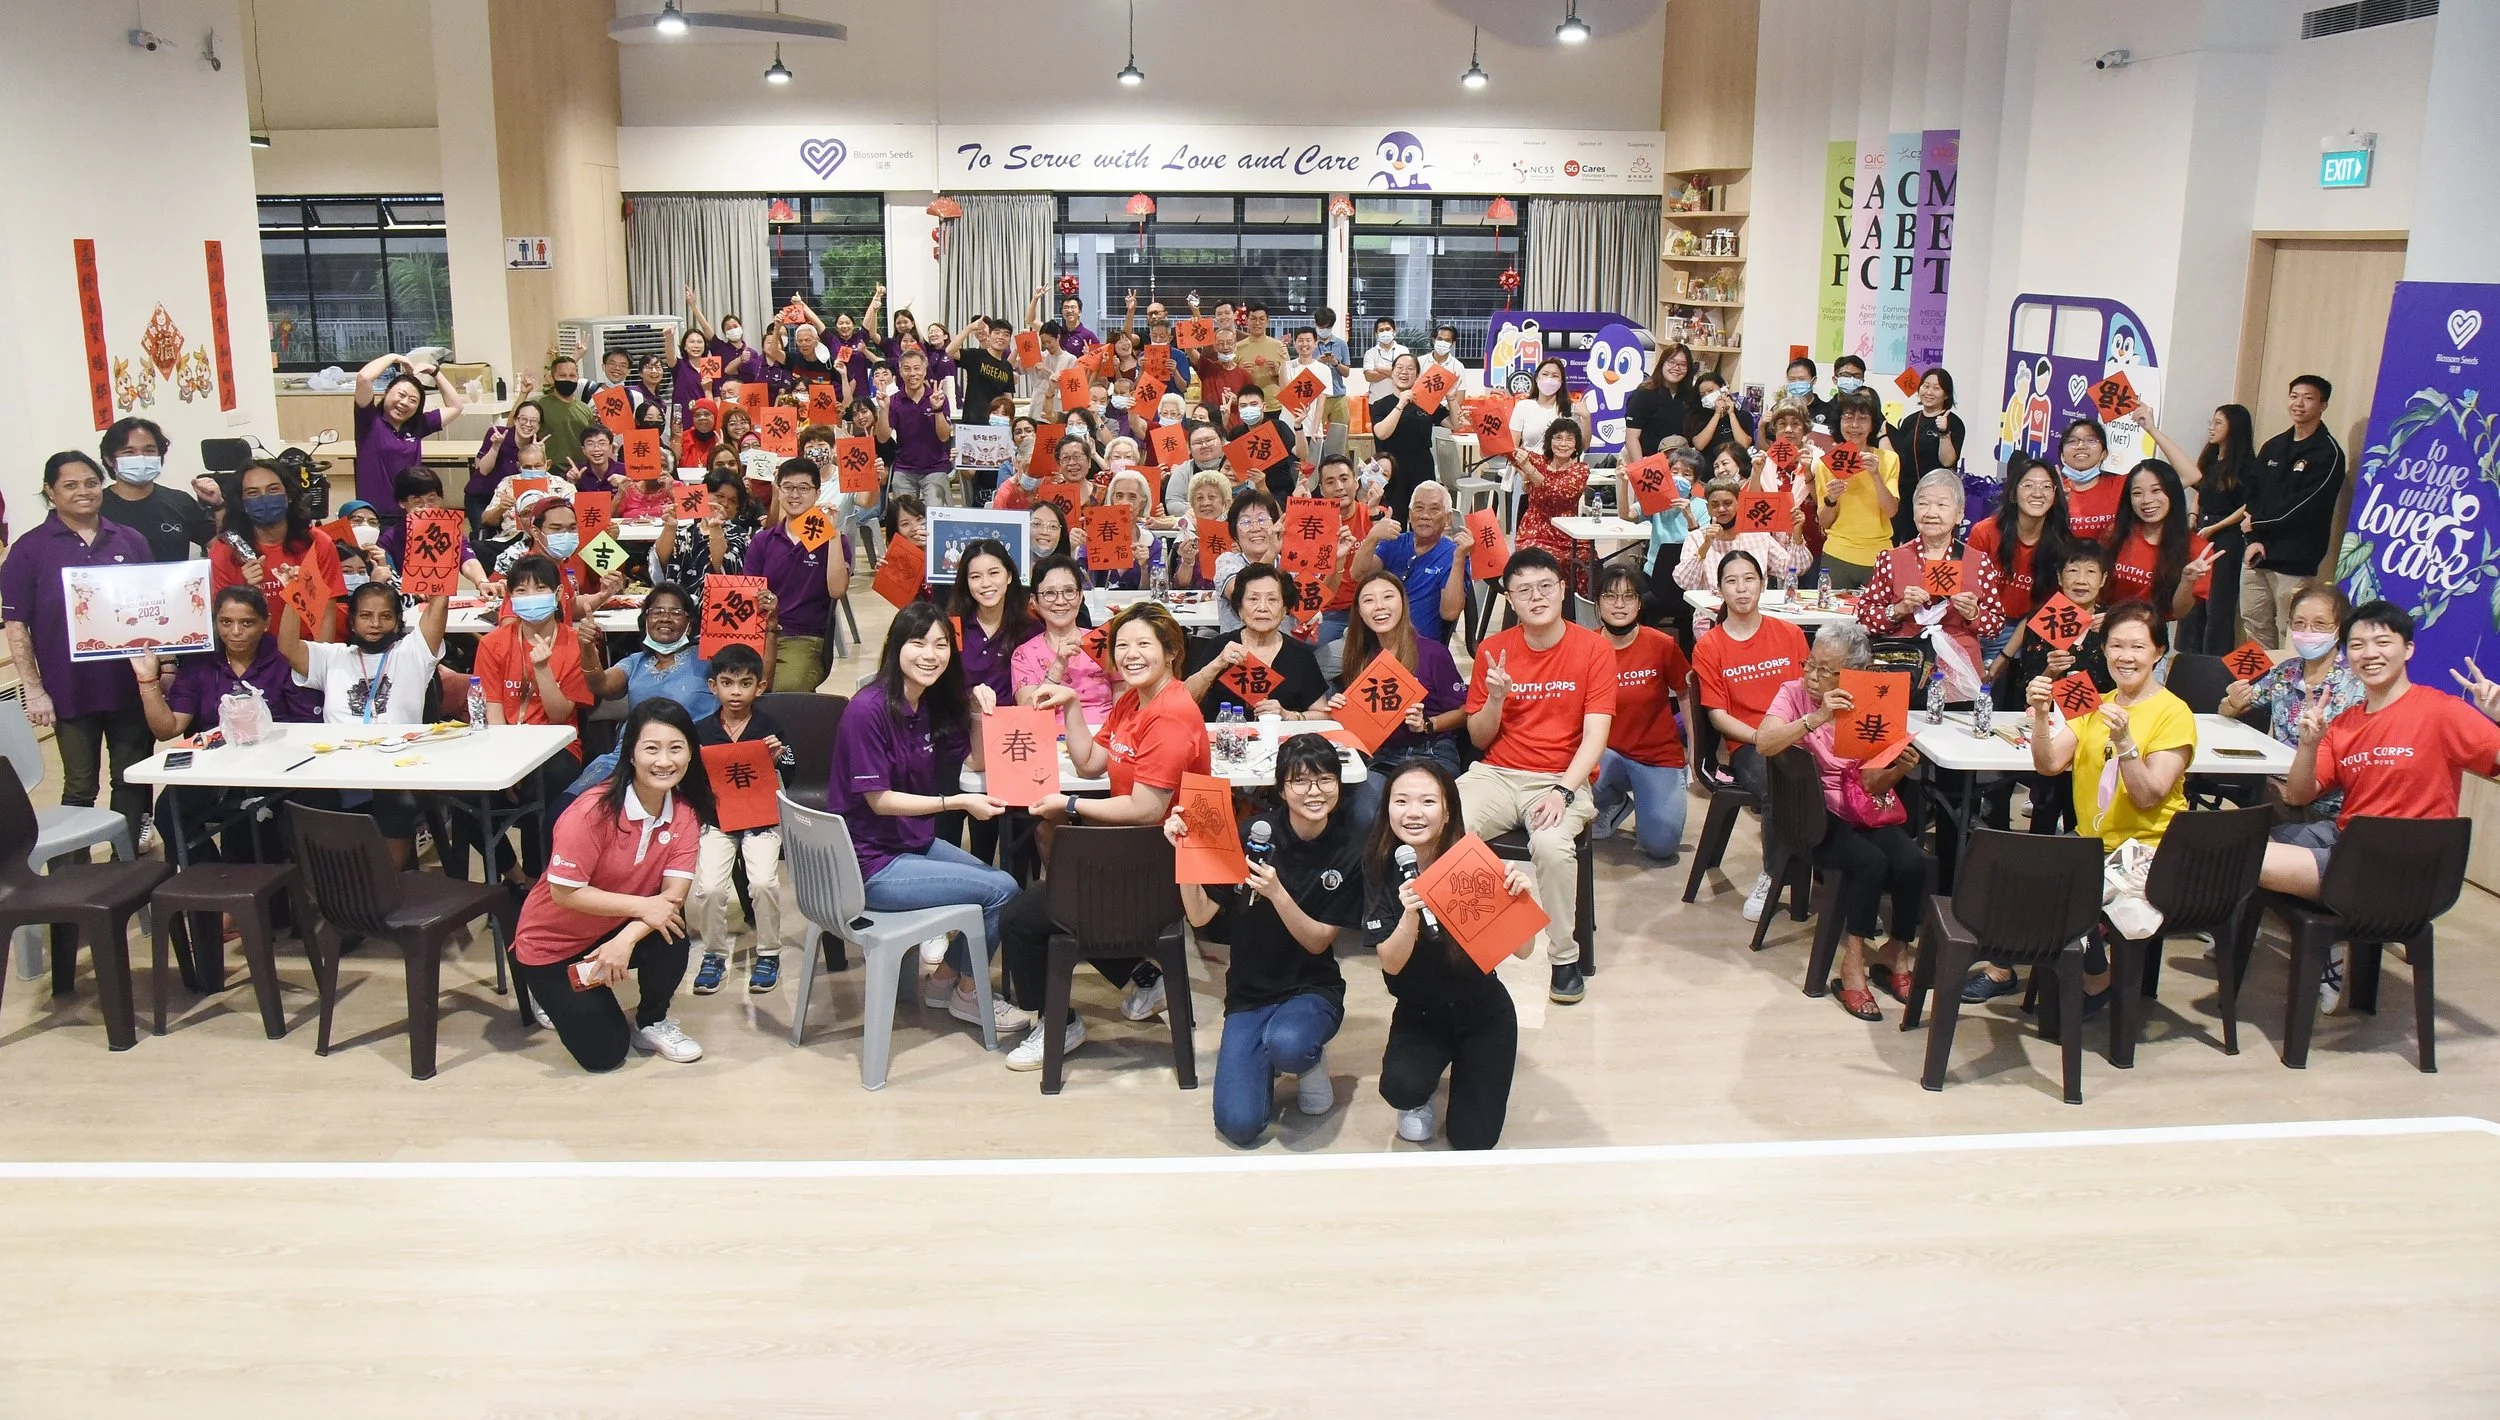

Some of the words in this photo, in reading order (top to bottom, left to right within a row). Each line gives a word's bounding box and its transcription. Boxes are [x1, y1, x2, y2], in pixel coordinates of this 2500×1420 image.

[853, 150, 888, 159] Blossom
[889, 150, 914, 159] Seeds
[957, 143, 993, 171] To
[1003, 144, 1081, 171] Serve
[1093, 143, 1152, 169] with
[1161, 144, 1227, 171] Love
[1237, 146, 1290, 170] and
[1294, 144, 1360, 175] Care
[1530, 166, 1555, 175] NCSS
[1565, 163, 1579, 174] SG
[1581, 164, 1606, 174] Cares
[2324, 157, 2356, 182] EXIT
[2436, 354, 2460, 364] Blossom
[2461, 356, 2479, 365] Seeds
[1066, 377, 1081, 393] 春
[1138, 383, 1157, 402] 福
[1294, 380, 1314, 399] 福
[1422, 373, 1445, 394] 福
[765, 415, 791, 440] 福
[1479, 413, 1503, 437] 福
[632, 440, 651, 458] 春
[1247, 434, 1272, 461] 福
[2109, 431, 2131, 447] (MET)
[2427, 438, 2448, 463] to
[841, 446, 870, 472] 福
[1772, 442, 1794, 463] 春
[1636, 467, 1665, 493] 福
[2394, 456, 2470, 491] serve
[679, 489, 704, 513] 春
[2399, 484, 2450, 514] with
[581, 506, 602, 528] 春
[2358, 483, 2436, 545] love
[1097, 520, 1119, 542] 春
[1298, 514, 1325, 541] 春
[1480, 525, 1497, 550] 春
[414, 522, 452, 563] 福
[1207, 534, 1227, 555] 春
[592, 542, 615, 569] 吉
[2381, 537, 2470, 591] care
[1926, 561, 1959, 593] 春
[2115, 562, 2145, 577] OUTH
[138, 605, 161, 619] 2023
[710, 590, 756, 631] 福
[2039, 606, 2083, 640] 福
[1757, 657, 1791, 671] CORPS
[2233, 648, 2266, 676] 春
[1230, 666, 1272, 695] 福
[1618, 679, 1646, 687] APORE
[1623, 668, 1657, 681] CORPS
[1733, 668, 1782, 683] SINGAPORE
[1360, 677, 1403, 714] 福
[1510, 682, 1542, 693] OUTH
[2057, 677, 2095, 713] 春
[1001, 729, 1036, 762] 春
[2339, 751, 2370, 767] YOUT
[2372, 746, 2415, 757] CORPS
[724, 762, 759, 789] 春
